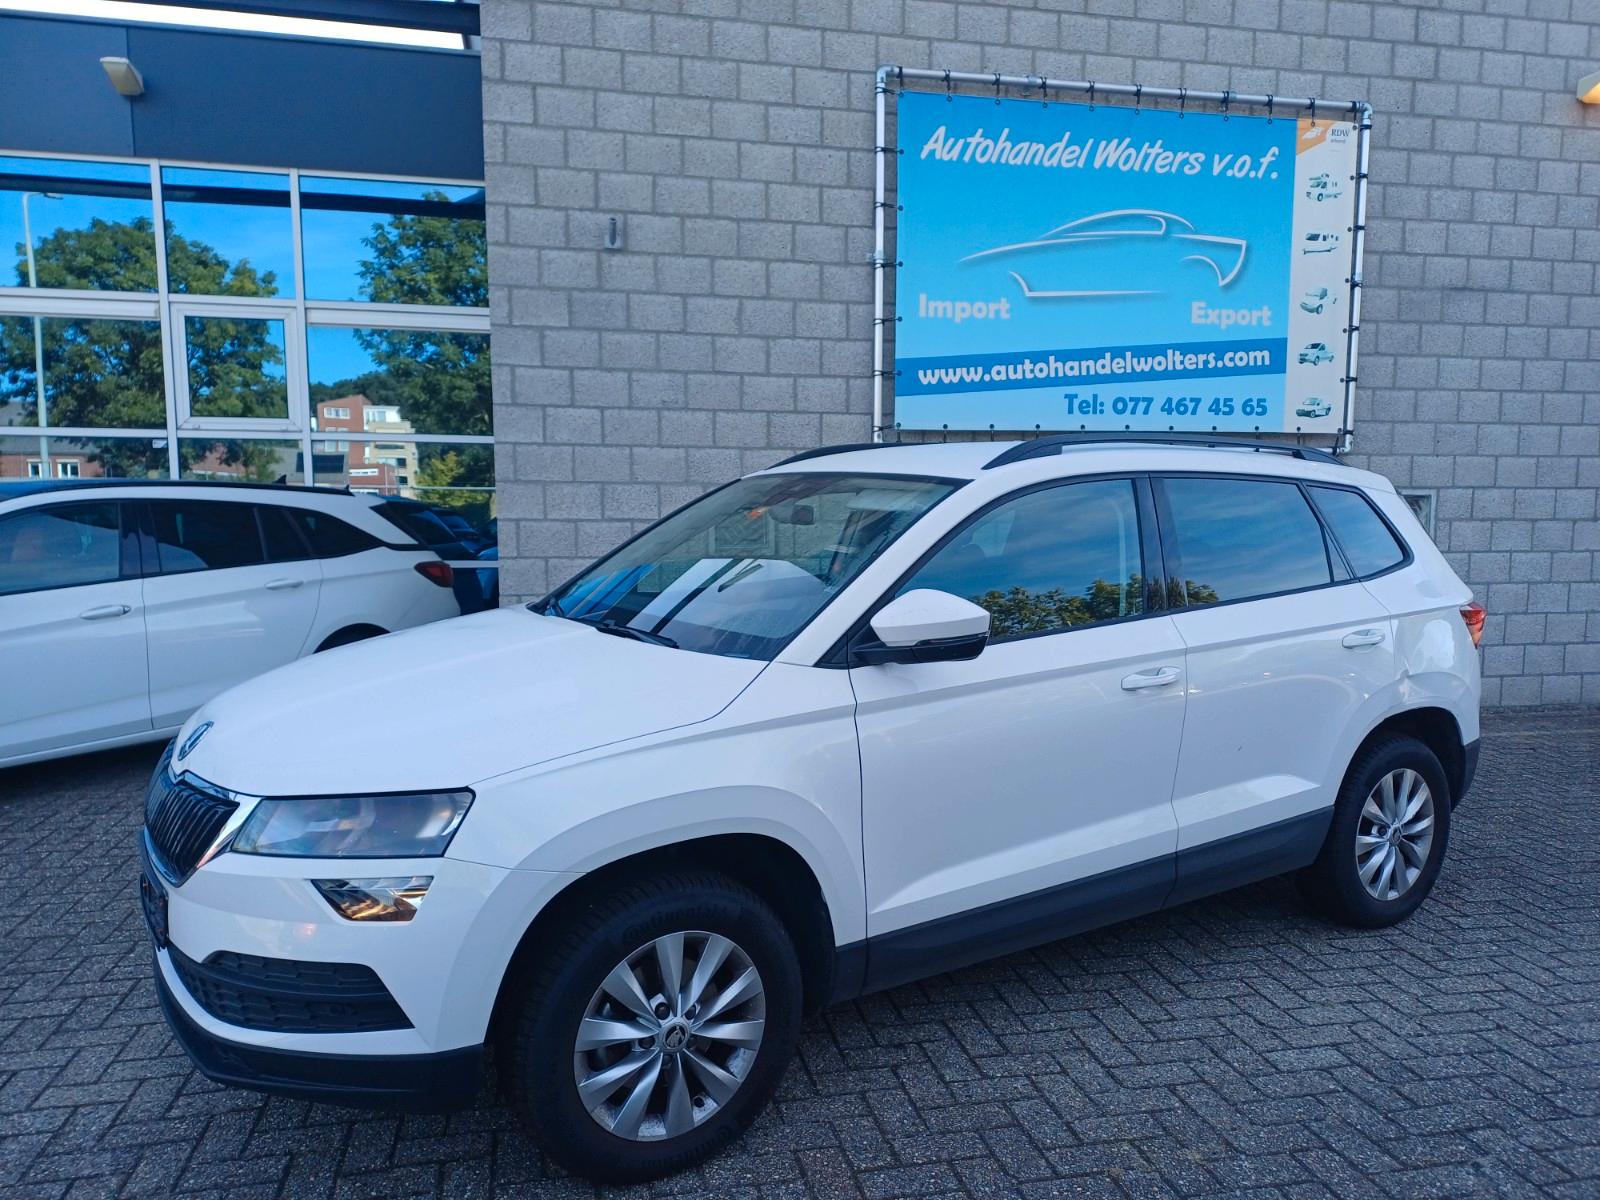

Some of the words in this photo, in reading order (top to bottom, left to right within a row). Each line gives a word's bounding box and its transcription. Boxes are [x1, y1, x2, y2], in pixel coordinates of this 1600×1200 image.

[1331, 128, 1350, 137] RDW
[920, 125, 1094, 169] Autohandel
[1093, 137, 1206, 175] Wolters
[1212, 146, 1279, 180] v.o.f.
[918, 293, 1011, 323] Import
[1191, 301, 1272, 330] Export
[918, 349, 1270, 385] www.autohandelwolters.com
[1064, 393, 1105, 415] Tel:
[1112, 396, 1154, 416] 077
[1160, 396, 1203, 416] 467
[1208, 397, 1235, 416] 45
[1241, 397, 1268, 417] 65
